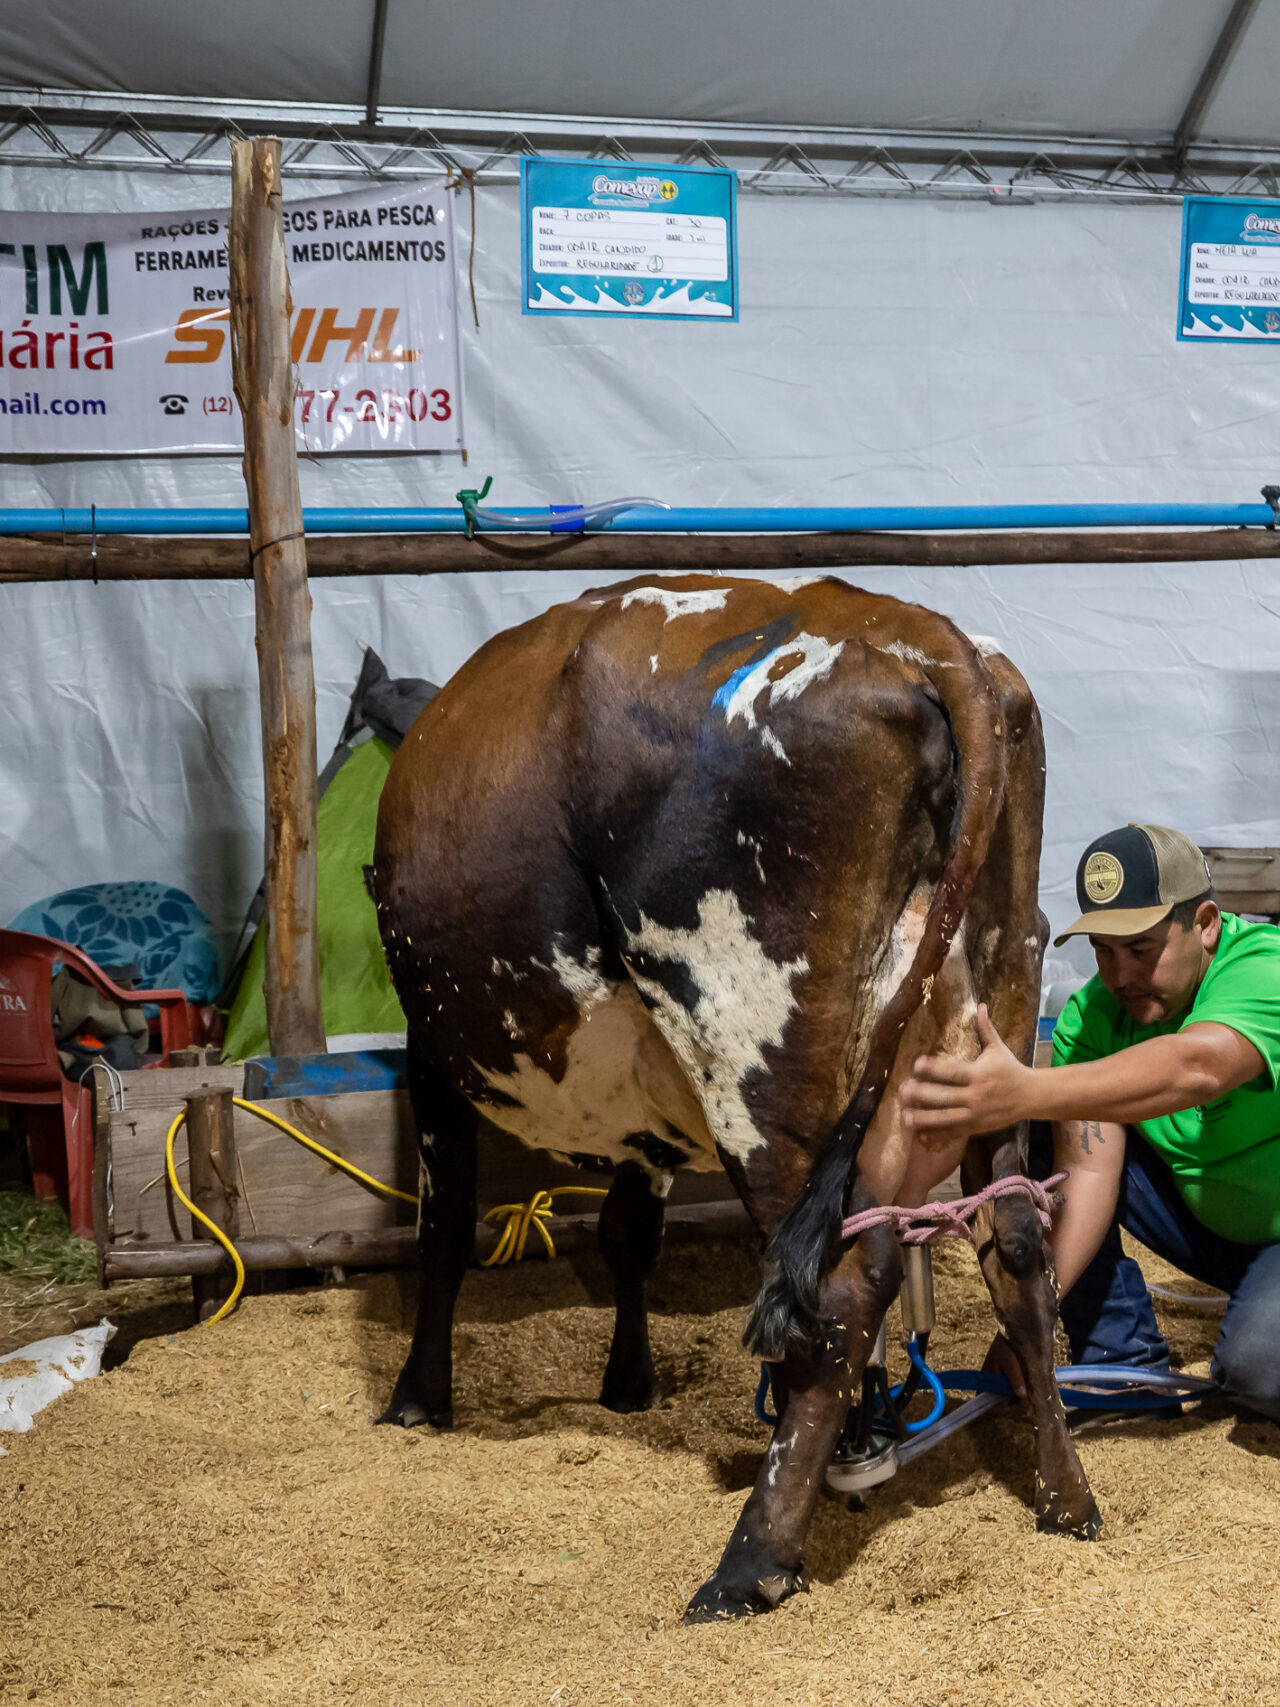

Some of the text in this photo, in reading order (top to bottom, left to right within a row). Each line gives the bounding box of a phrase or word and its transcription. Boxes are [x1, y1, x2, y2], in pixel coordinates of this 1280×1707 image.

[141, 218, 219, 241] RAÇÕES
[323, 208, 372, 230] PARA
[377, 204, 437, 226] PESCA
[134, 240, 446, 272] FERRAME MEDICAMENTOS
[165, 308, 423, 364] SIHL
[202, 396, 233, 416] (12)
